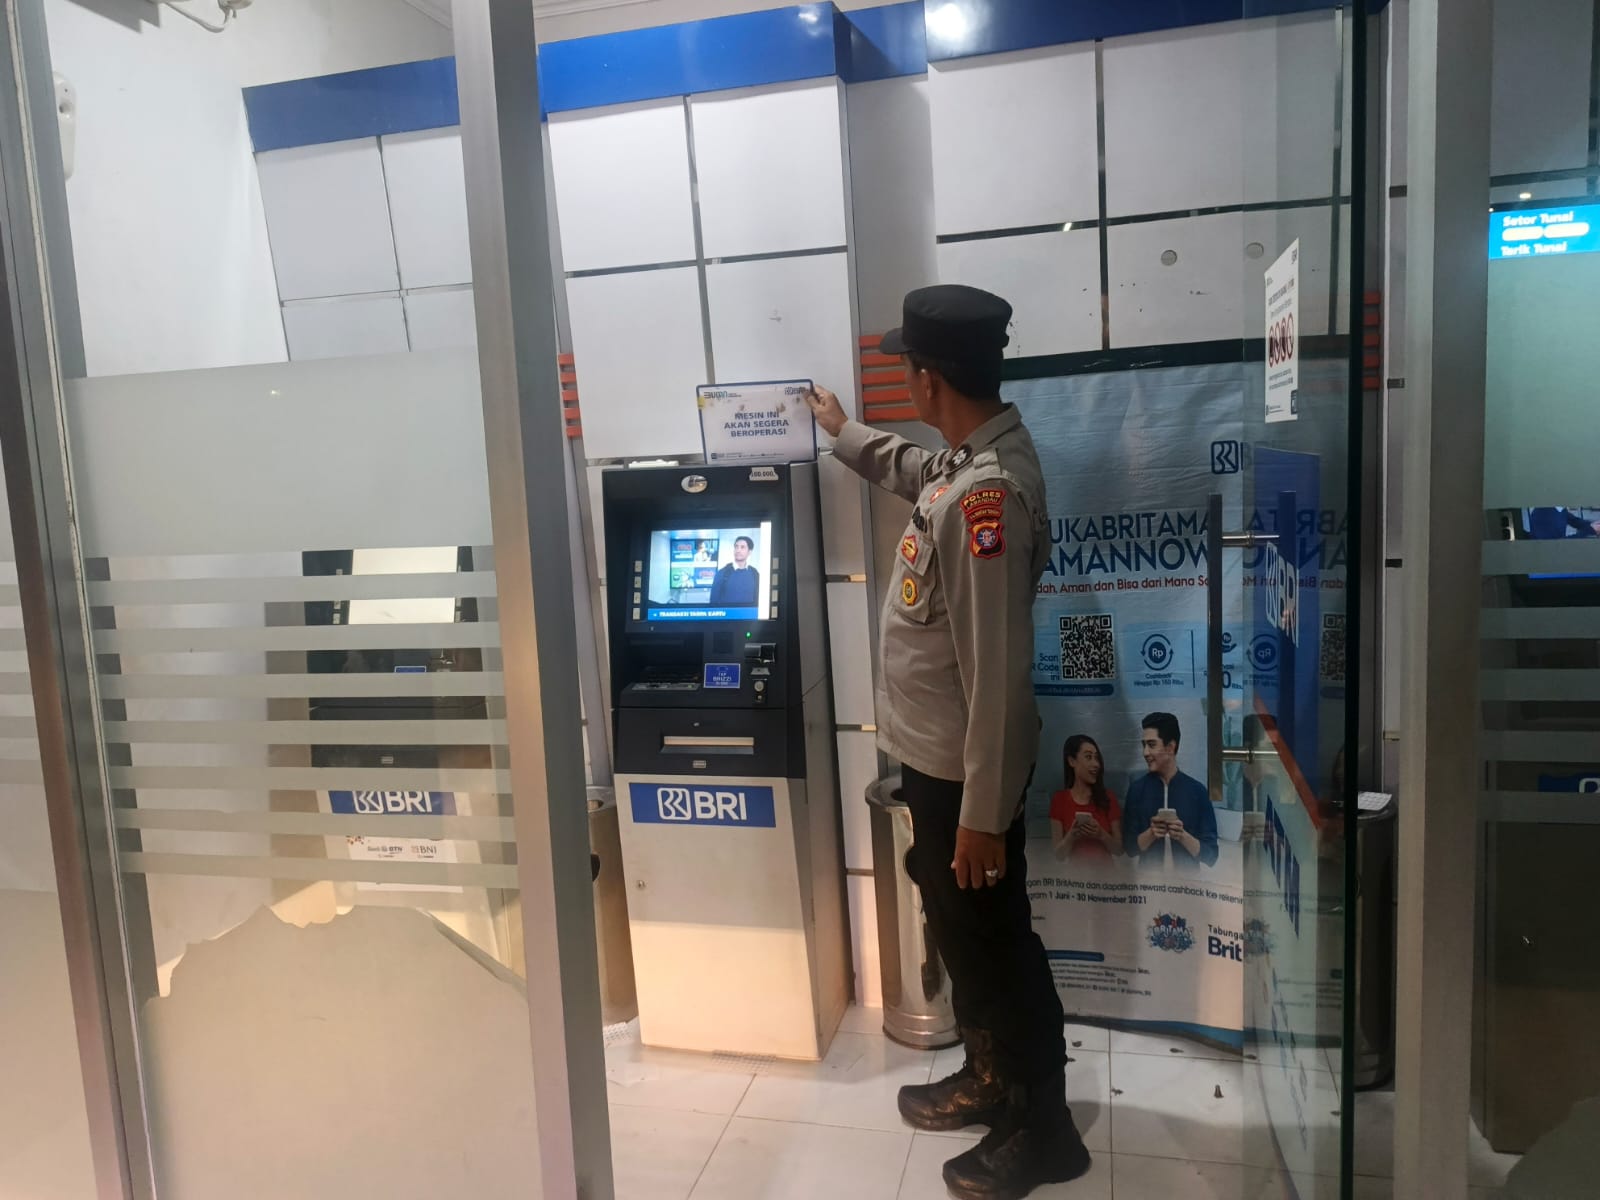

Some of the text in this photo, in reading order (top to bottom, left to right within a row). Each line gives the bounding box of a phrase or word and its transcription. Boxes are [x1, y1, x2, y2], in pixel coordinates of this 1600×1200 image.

[735, 411, 764, 420] MESIN
[724, 419, 789, 429] AKAN SEGERA
[731, 428, 786, 437] BEROPERASI
[963, 491, 1001, 507] POLRES
[1049, 511, 1208, 543] UKABRITAMA
[1042, 538, 1208, 576] AMANNOW
[1036, 584, 1058, 594] dah,
[1060, 582, 1091, 593] Aman
[1095, 580, 1114, 590] dan
[1118, 579, 1138, 590] Bisa
[1141, 578, 1161, 589] dari
[1165, 577, 1194, 587] Mana
[1040, 654, 1058, 663] Scan
[1151, 648, 1164, 658] Rp
[1038, 663, 1059, 672] Code
[1050, 672, 1060, 680] ini
[694, 791, 747, 820] BRI
[1026, 879, 1041, 889] gan
[1043, 878, 1055, 886] BRI
[1086, 881, 1101, 889] dan
[1102, 881, 1138, 892] dapatkan
[1140, 883, 1166, 892] reward
[1168, 884, 1203, 897] cashback
[1206, 889, 1217, 899] ke
[1055, 891, 1070, 900] Juni
[1077, 893, 1086, 901] 30
[1088, 894, 1126, 904] November
[1128, 895, 1147, 904] 2021
[1208, 924, 1243, 940] Tabunga
[1207, 936, 1242, 962] Brit
